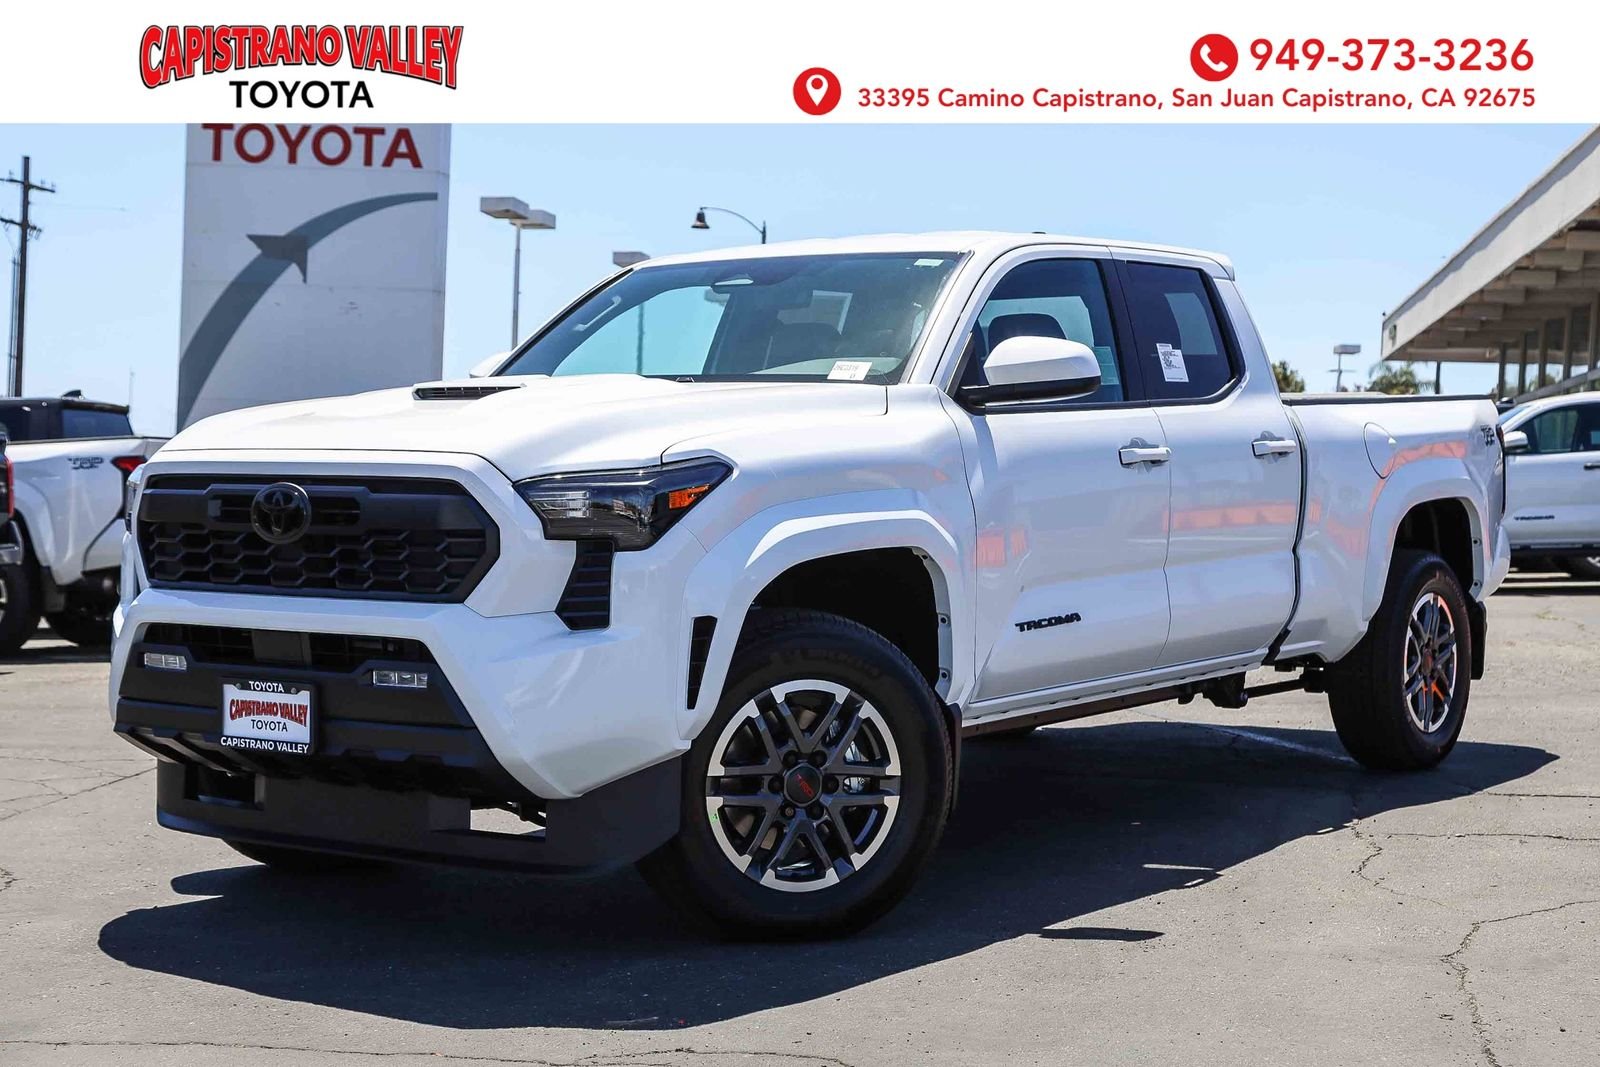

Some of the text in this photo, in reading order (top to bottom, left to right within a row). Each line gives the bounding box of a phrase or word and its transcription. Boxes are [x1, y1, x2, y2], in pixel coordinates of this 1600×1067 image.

[201, 123, 423, 169] TOYOTA
[1015, 612, 1081, 632] TACOMA
[248, 681, 284, 693] TOYOTA
[229, 699, 308, 728] CAPISTRANO VALLEY
[251, 719, 288, 732] TOYOTA
[220, 737, 309, 754] CAPISTRANO VALLEY
